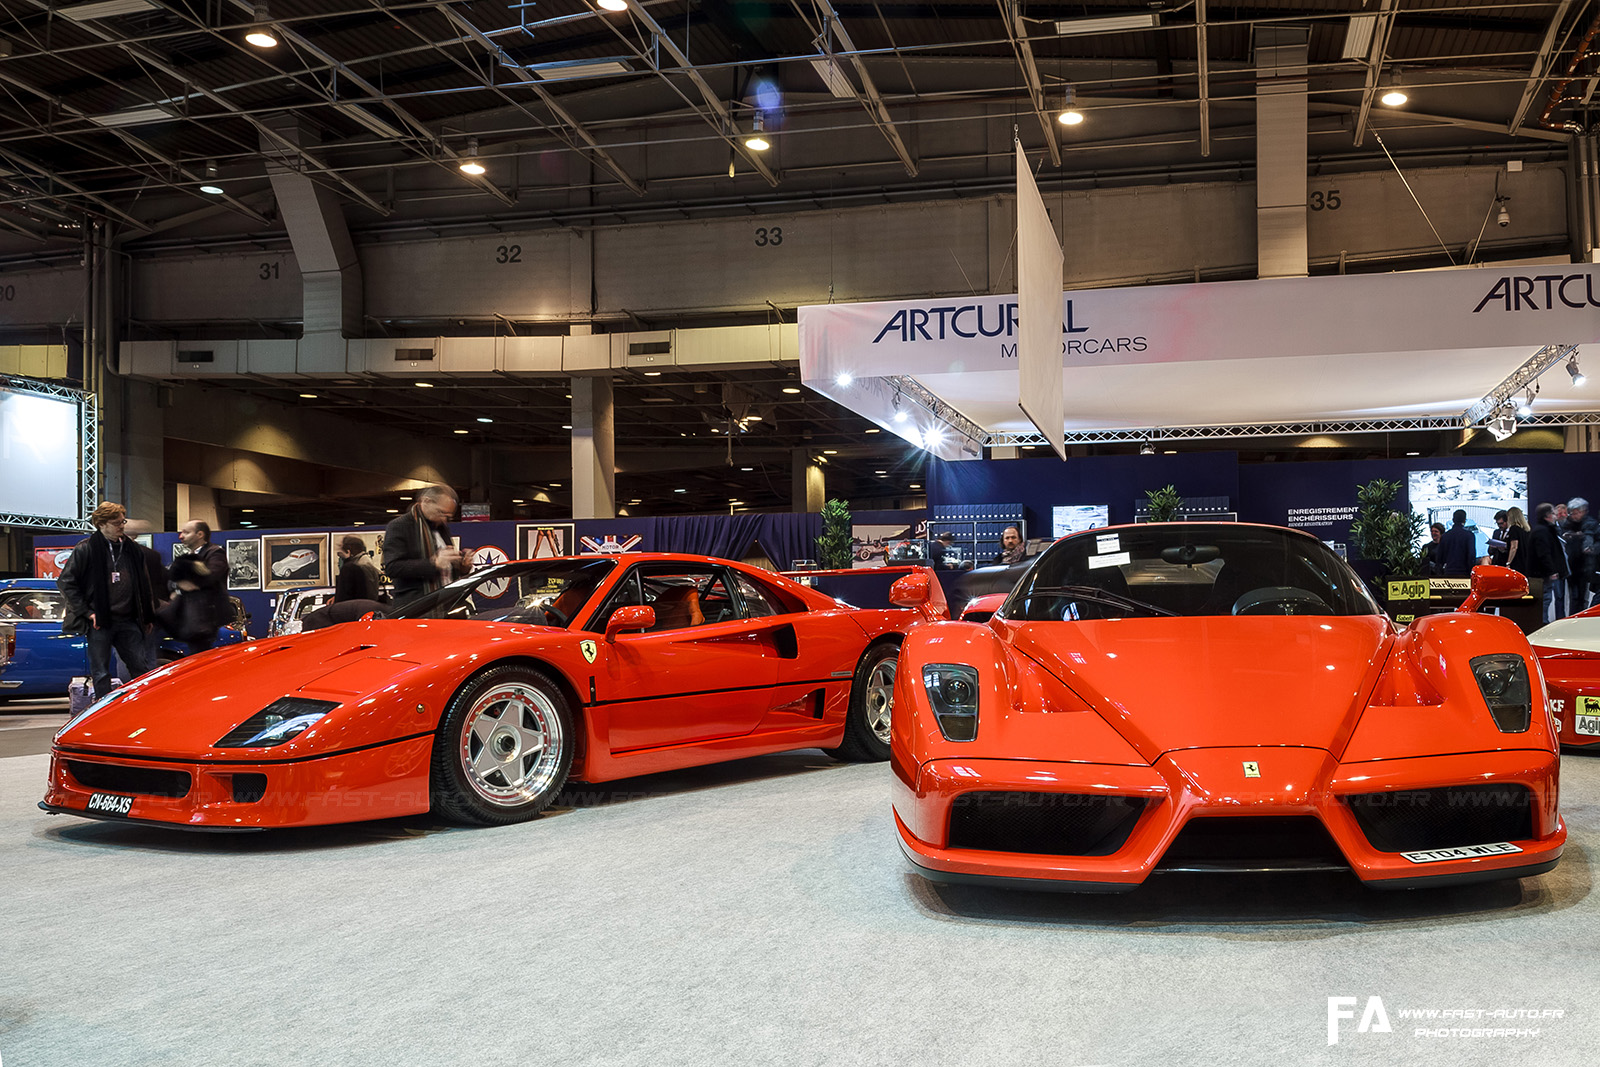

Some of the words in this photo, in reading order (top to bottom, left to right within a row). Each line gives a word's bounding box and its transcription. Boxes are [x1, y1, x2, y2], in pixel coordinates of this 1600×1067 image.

[1310, 189, 1341, 211] 35
[755, 226, 783, 246] 33
[496, 244, 521, 264] 32
[259, 261, 279, 280] 31
[1472, 274, 1600, 313] ARTCU
[872, 299, 1090, 344] ARTCURL
[1001, 336, 1148, 358] MRCARS
[1287, 506, 1359, 515] ENREGISTREMENT
[1287, 513, 1354, 522] ENCHÉRISSEURS
[1401, 581, 1425, 598] Agip
[1549, 699, 1565, 712] KF
[1578, 716, 1600, 734] Agi
[88, 793, 132, 814] CN-664-XS
[1406, 849, 1468, 861] ET04
[1469, 843, 1517, 856] WLE
